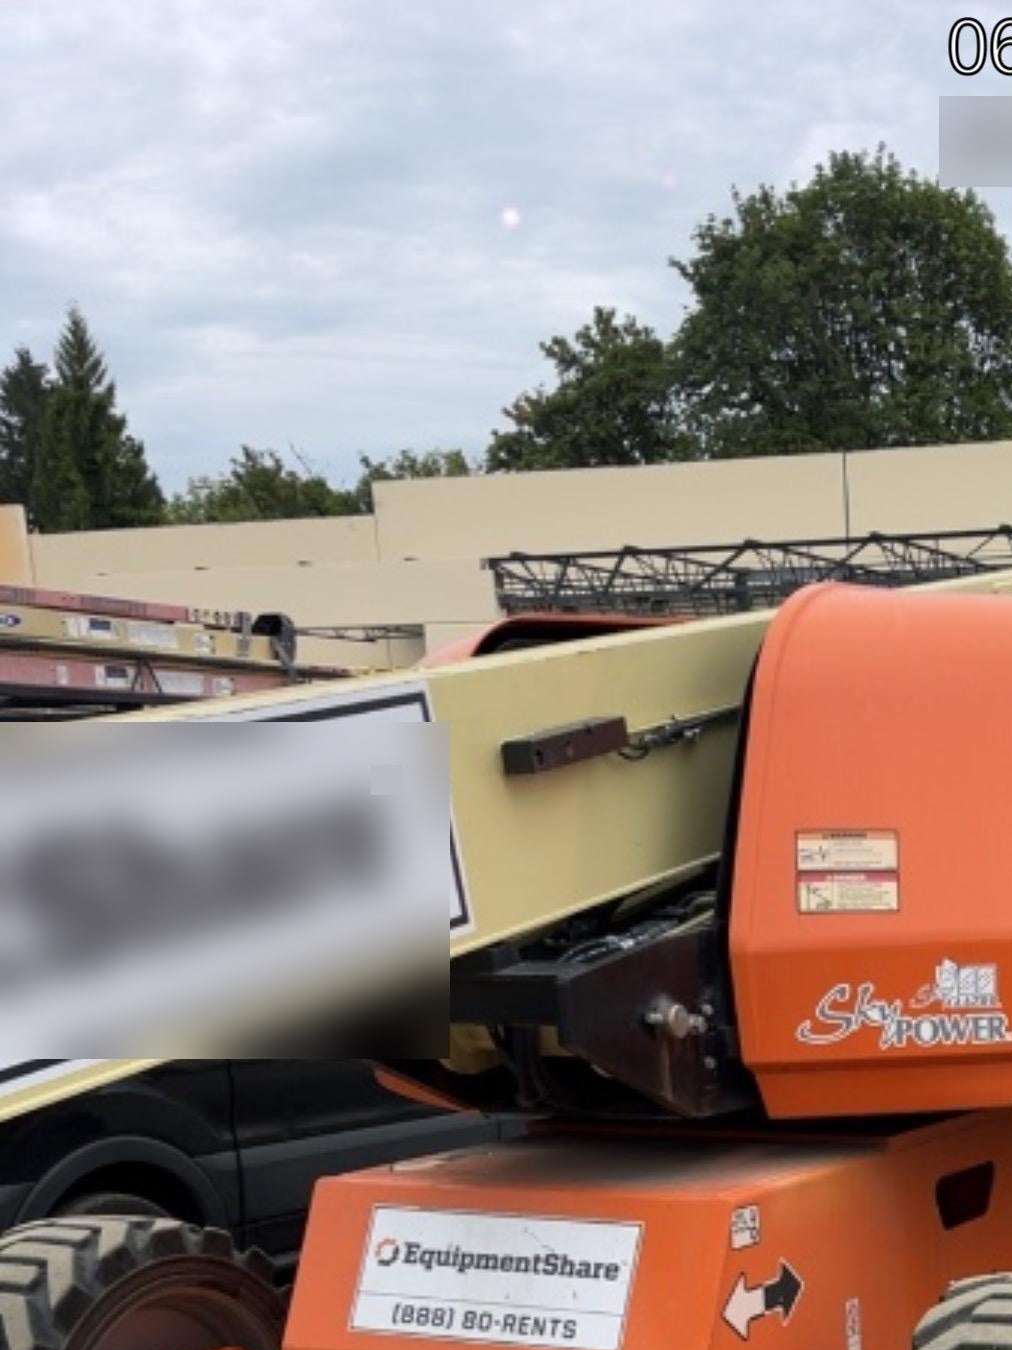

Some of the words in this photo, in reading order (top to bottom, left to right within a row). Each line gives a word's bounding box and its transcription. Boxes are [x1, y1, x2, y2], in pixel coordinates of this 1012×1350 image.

[796, 982, 903, 1050] Sky
[893, 1013, 1012, 1047] POWER
[401, 1241, 620, 1281] EquipmentShare
[391, 1302, 454, 1329] (888)
[461, 1309, 578, 1339] 80-RENTS
